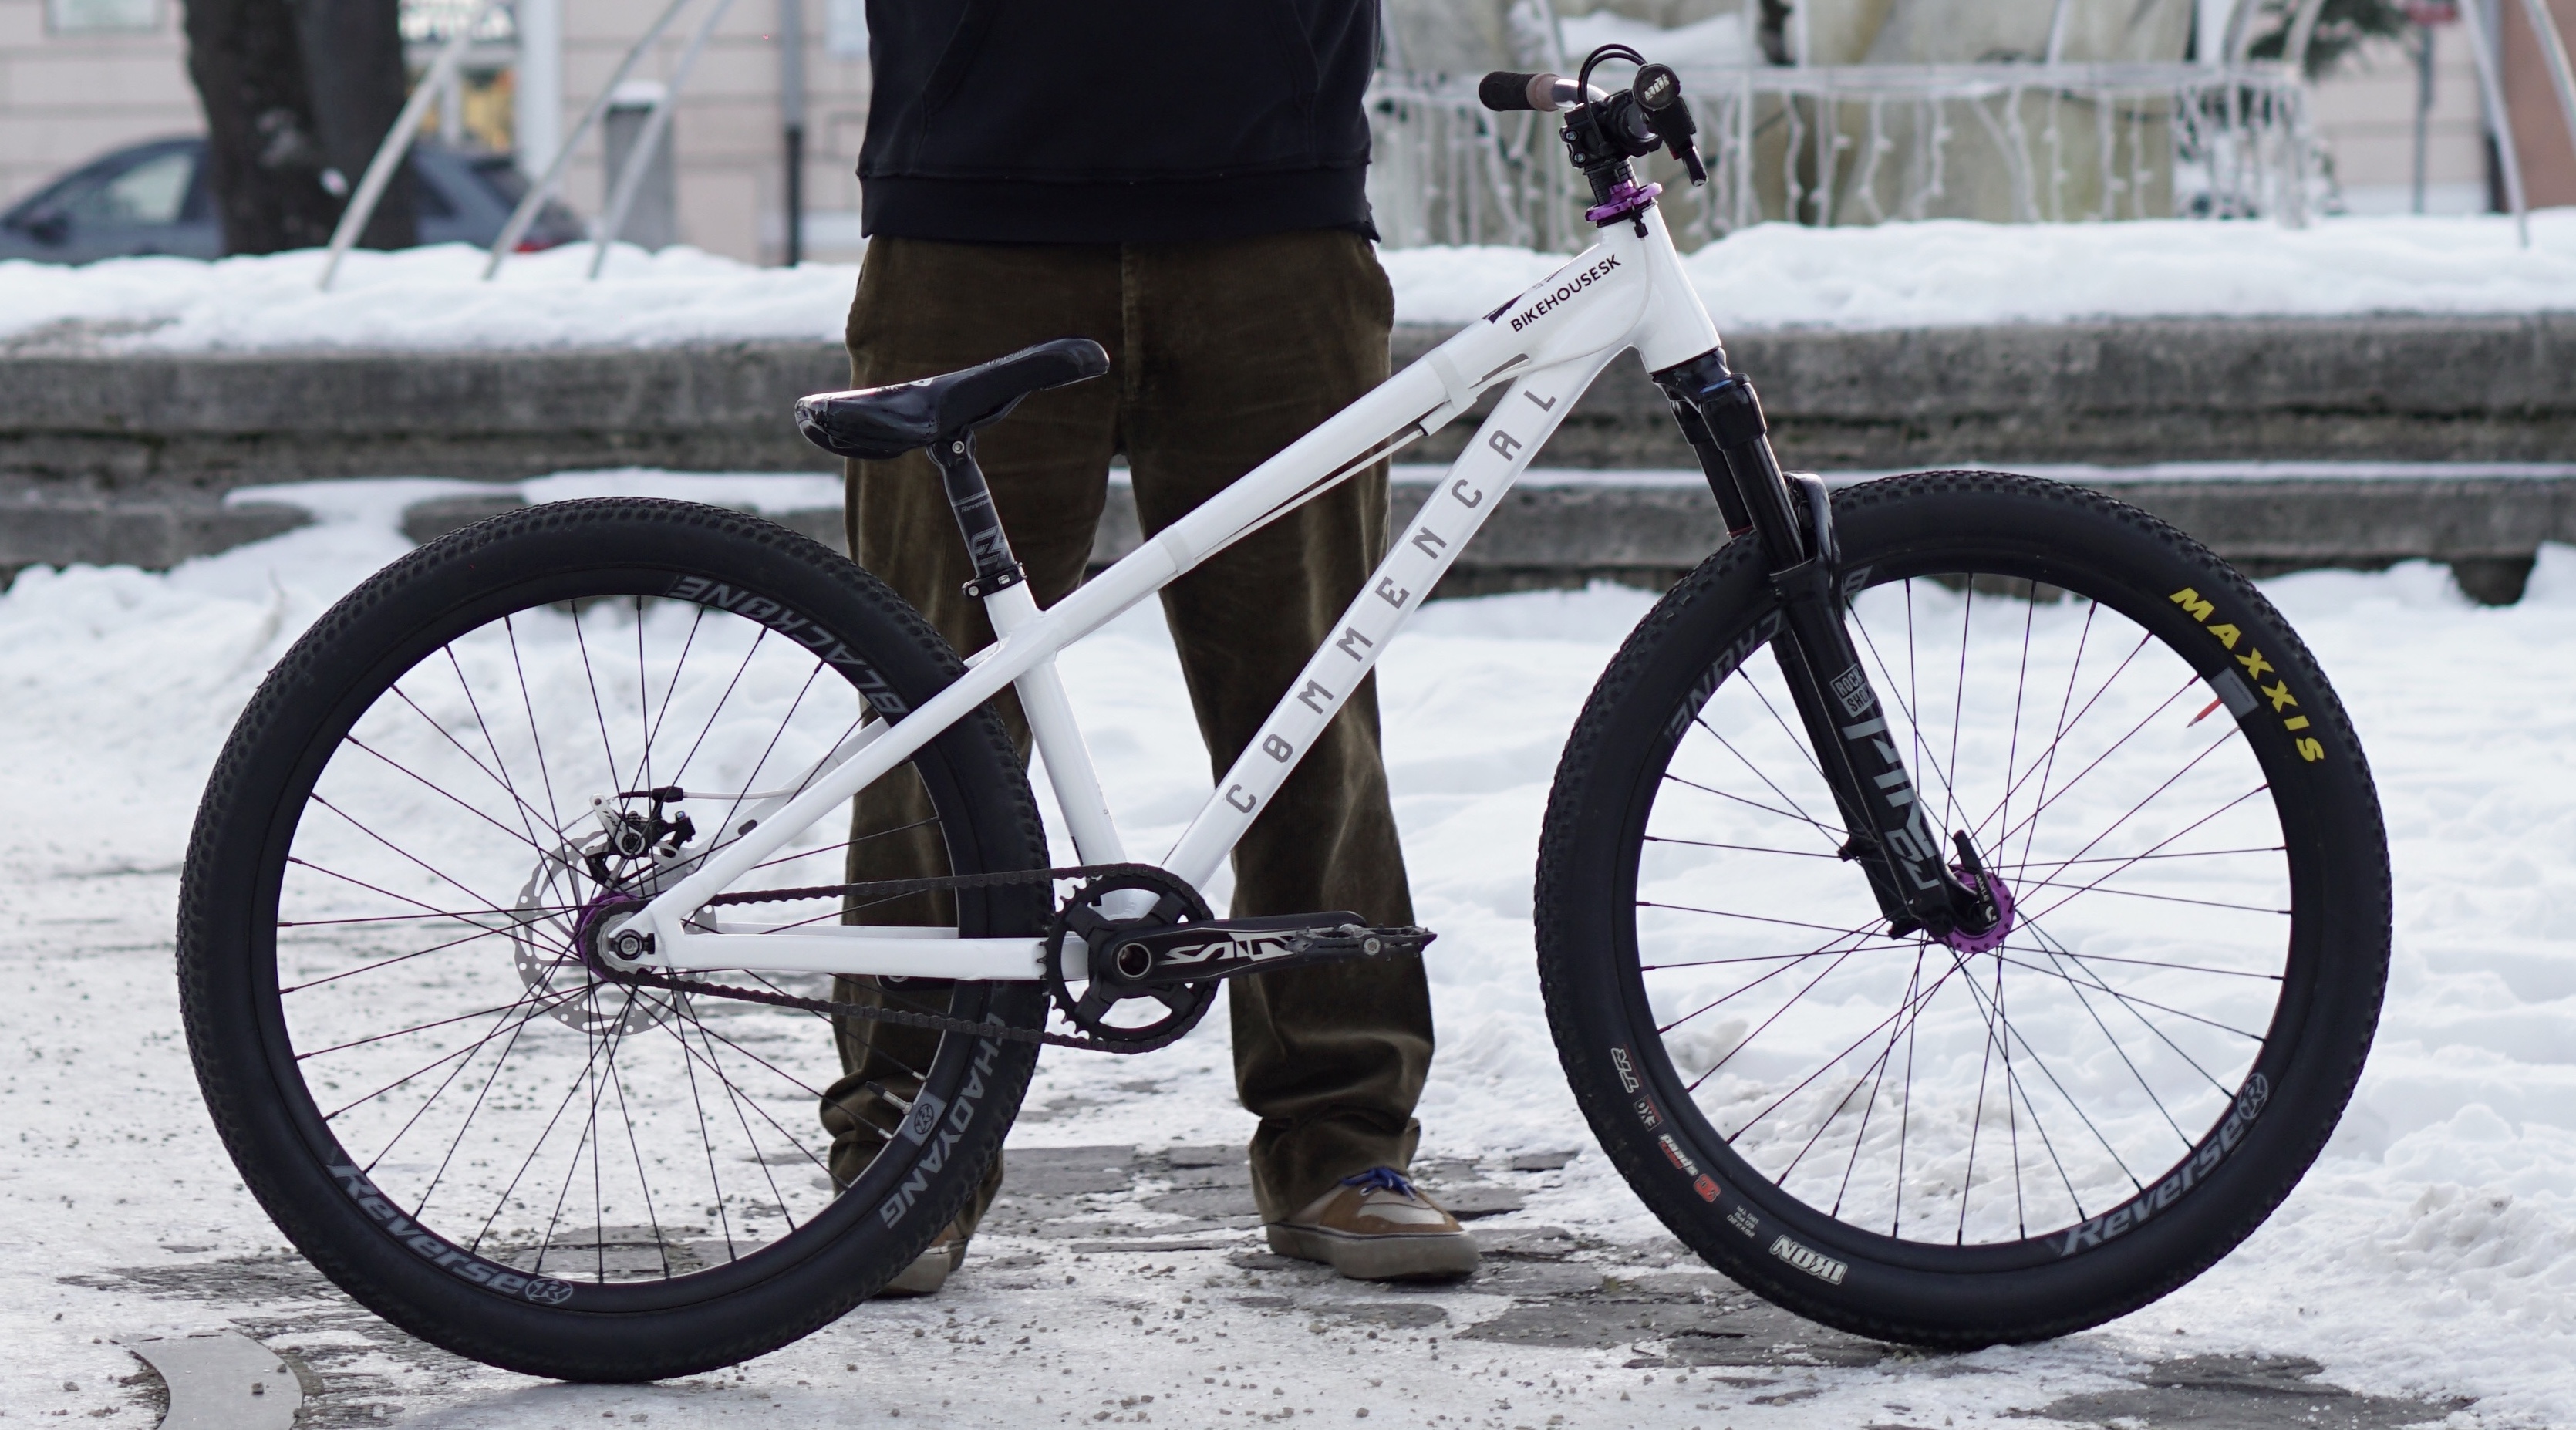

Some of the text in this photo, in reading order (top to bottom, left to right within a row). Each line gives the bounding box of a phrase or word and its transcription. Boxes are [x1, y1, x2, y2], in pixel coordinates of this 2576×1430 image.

[1510, 254, 1621, 332] BIKEHOUSESK
[1226, 389, 1556, 814] COMMENCAL
[1835, 668, 1863, 697] ROCK
[2169, 587, 2325, 762] MAXXIS
[1610, 1047, 1640, 1094] TR
[1635, 1099, 1658, 1131] EXO
[2060, 1116, 2244, 1257] Reverse
[325, 1163, 530, 1295] Reverse
[1771, 1235, 1847, 1284] IKON
